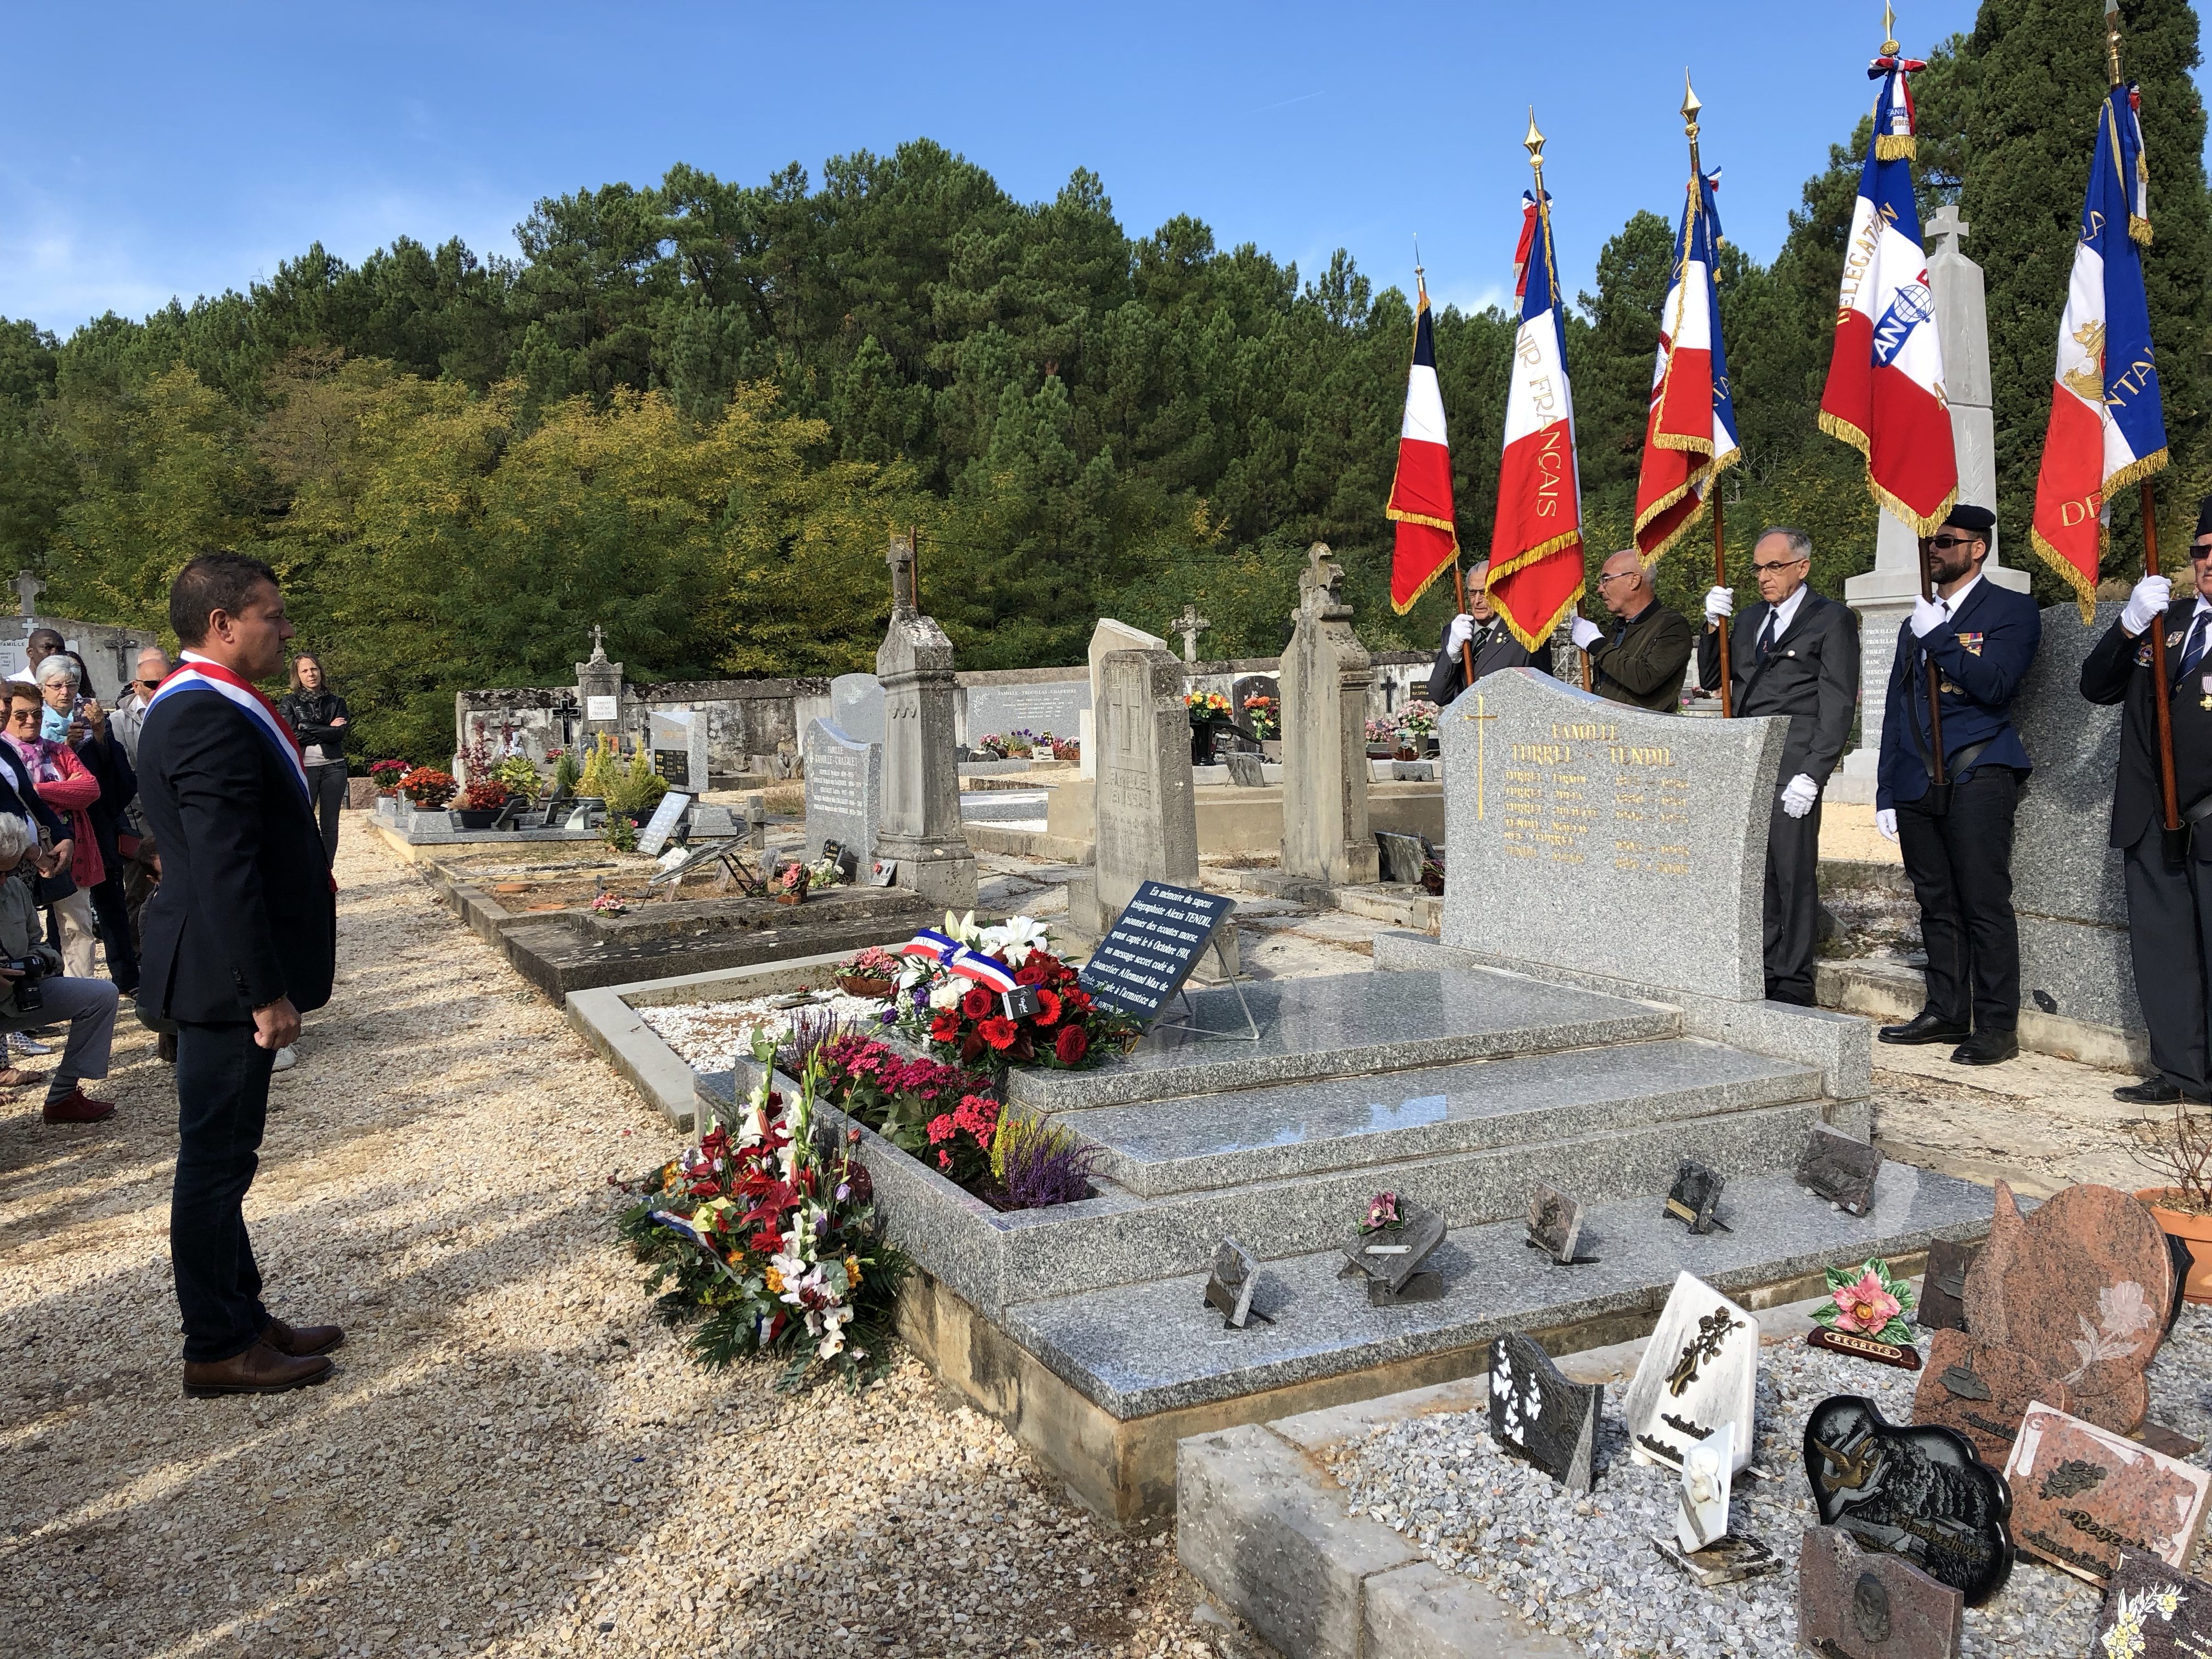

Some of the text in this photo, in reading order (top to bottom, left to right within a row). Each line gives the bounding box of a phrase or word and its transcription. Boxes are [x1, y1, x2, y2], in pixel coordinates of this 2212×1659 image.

[2103, 346, 2156, 429] NTA
[1516, 320, 1563, 518] NIR FRANÇAIS
[1552, 724, 1619, 740] FAMILLE
[1511, 744, 1573, 765] TURREL
[1609, 746, 1675, 766] TENDIL
[1149, 886, 1214, 909] En mémoire du sapeur
[1130, 900, 1211, 928] télégraphiste Alexis TENDIL,
[1121, 916, 1198, 943] pionnier des écoutes morse,
[1111, 930, 1190, 960] ayant capté le 6 Octobre 1918,
[1104, 946, 1176, 974] un message secret codé du
[1091, 960, 1169, 992] chancelier Allemand Max de
[1092, 978, 1113, 994] préude
[1113, 983, 1120, 994] à
[1119, 986, 1149, 1005] l'armistice
[1148, 997, 1158, 1008] du
[1097, 1000, 1124, 1014] novemre
[1834, 1335, 1891, 1355] REGRETS
[2072, 1510, 2152, 1555] Regre
[2174, 1637, 2194, 1652] pour
